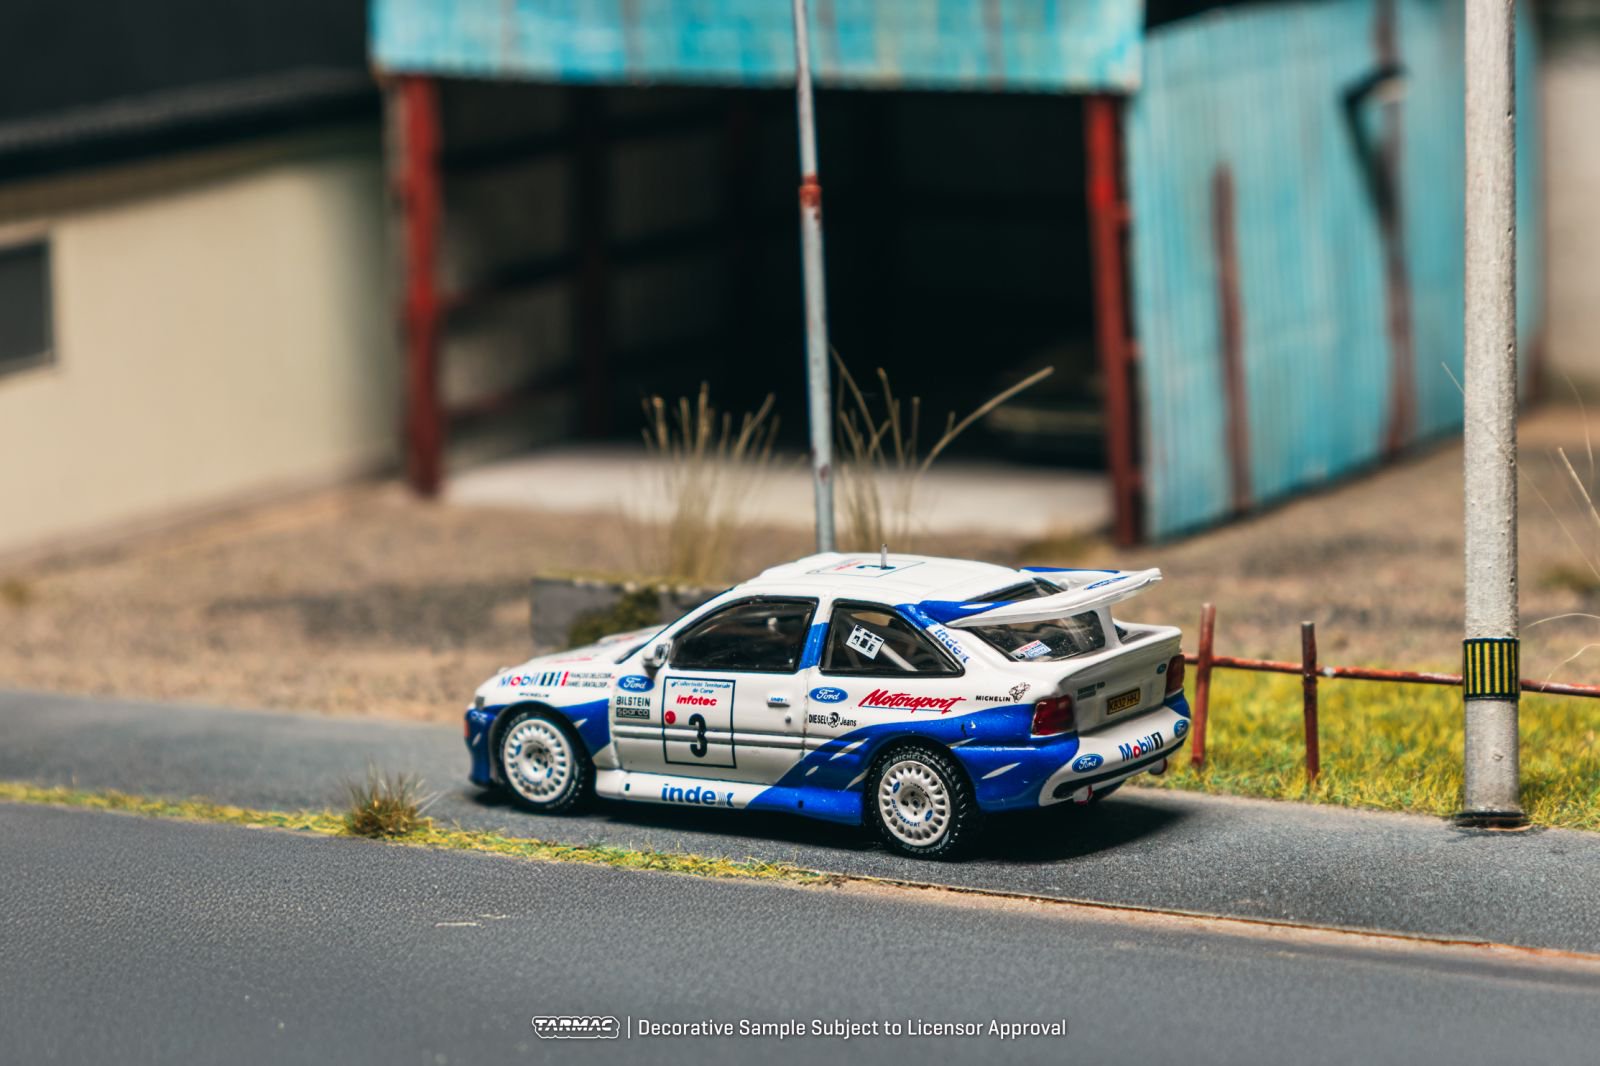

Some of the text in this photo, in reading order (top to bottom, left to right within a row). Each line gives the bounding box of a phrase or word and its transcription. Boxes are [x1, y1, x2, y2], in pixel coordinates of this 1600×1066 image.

[498, 672, 539, 688] Mobil
[623, 677, 648, 690] Ford
[676, 695, 718, 706] infotec
[815, 688, 841, 701] Ford
[858, 688, 967, 714] Motorsport
[975, 694, 1011, 702] MICHELIN
[616, 695, 651, 708] BILSTEIN
[808, 713, 827, 725] DIESEL
[688, 713, 708, 758] 3
[1118, 737, 1155, 762] Mobil
[1078, 758, 1097, 770] Ford
[661, 783, 735, 808] index
